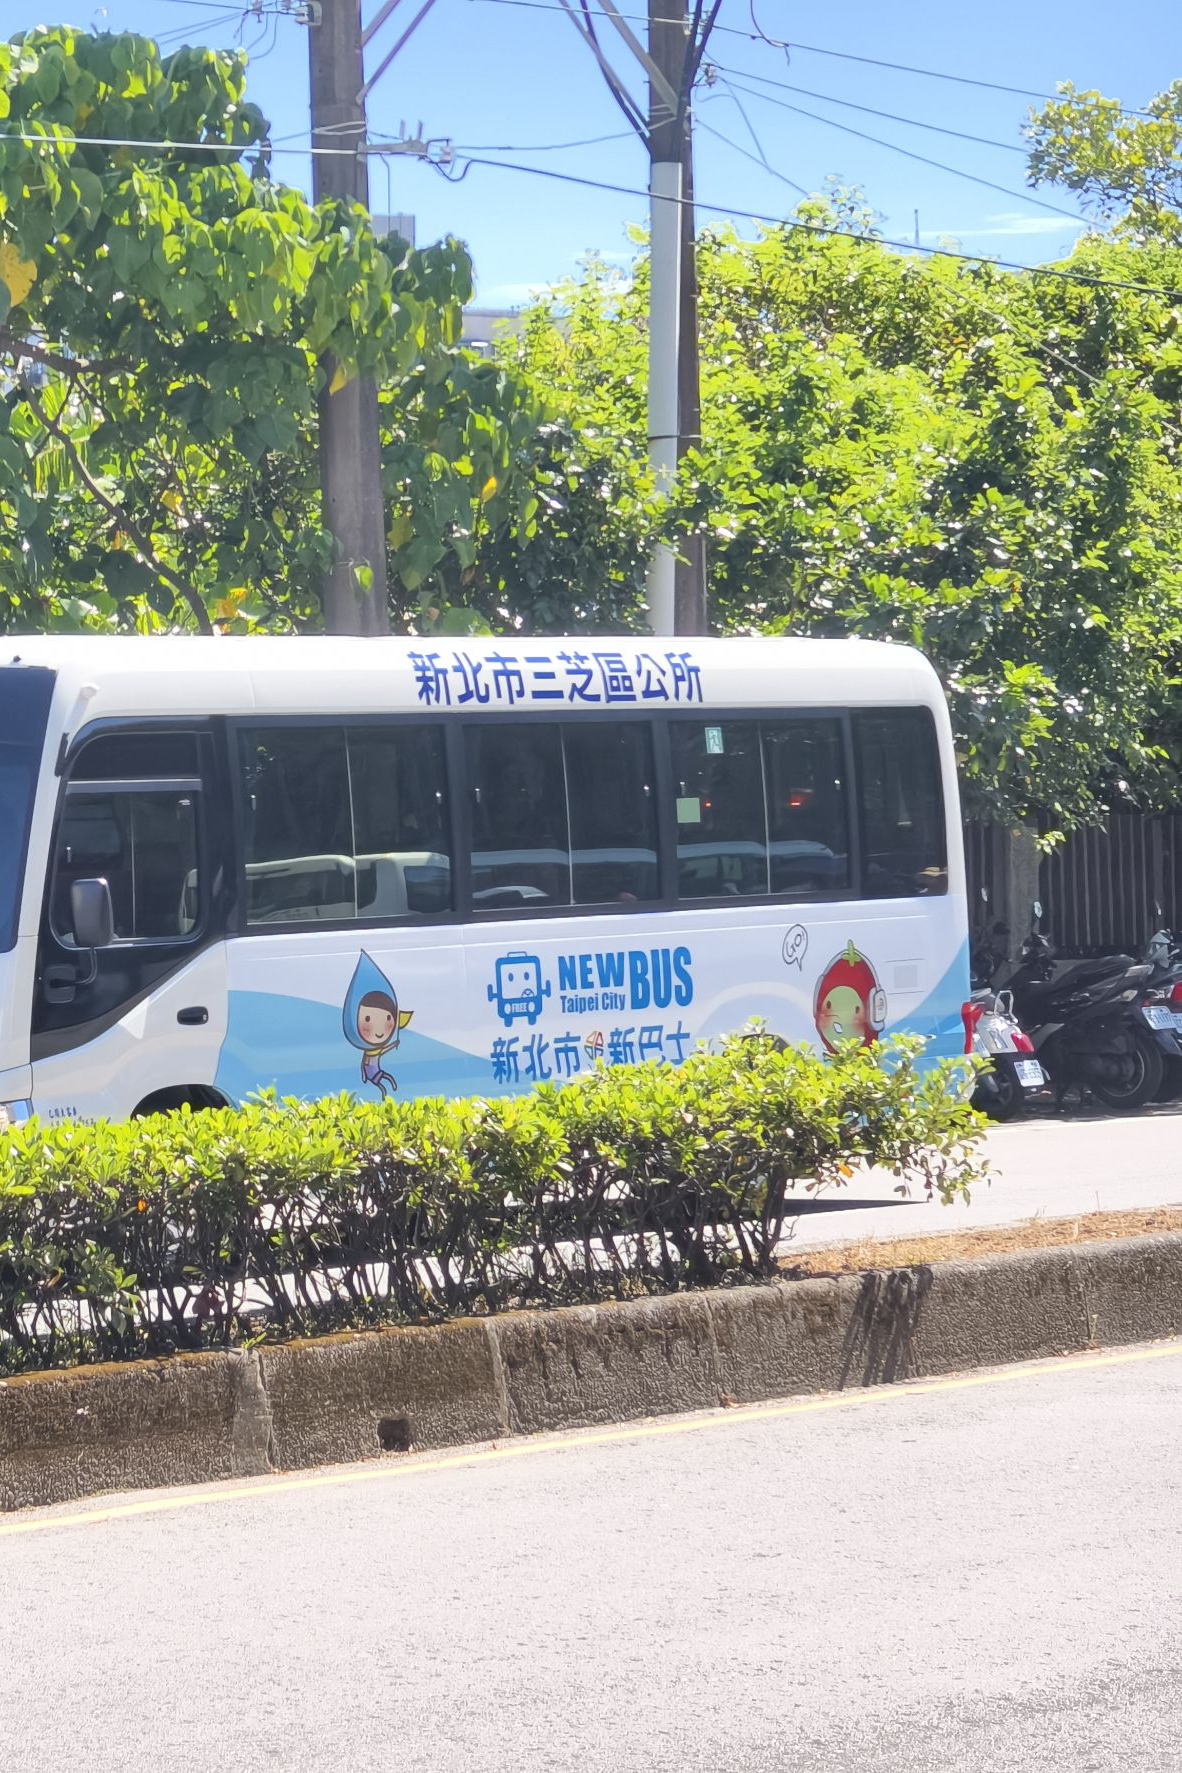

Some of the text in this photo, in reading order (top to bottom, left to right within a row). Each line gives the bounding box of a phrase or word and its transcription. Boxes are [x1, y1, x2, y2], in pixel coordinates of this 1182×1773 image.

[406, 650, 704, 706] 新北市三芝區公所
[558, 946, 694, 1010] NEW BUS
[560, 991, 626, 1014] Taipei City
[490, 1020, 691, 1085] 新北市 新巴士
